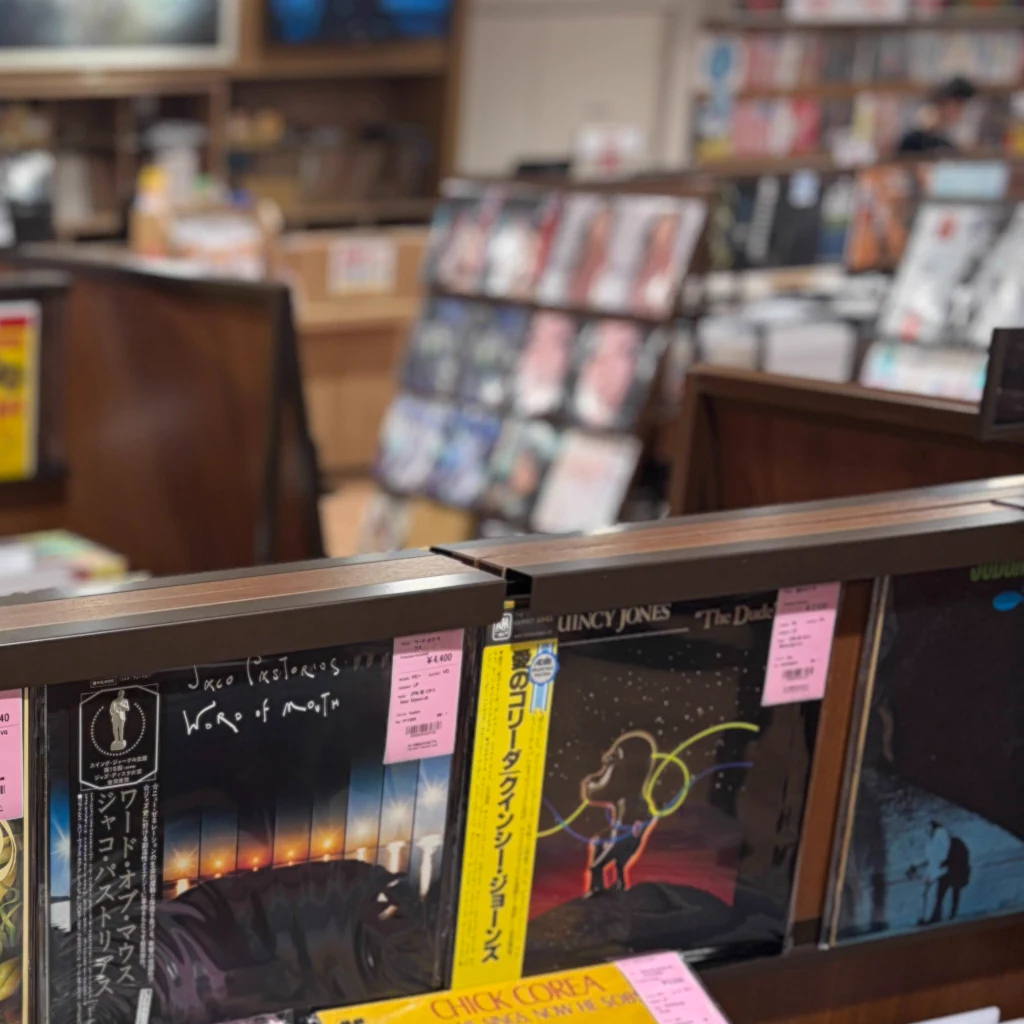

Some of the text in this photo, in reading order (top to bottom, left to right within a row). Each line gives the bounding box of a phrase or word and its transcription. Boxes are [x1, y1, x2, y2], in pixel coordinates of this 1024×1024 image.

[557, 609, 614, 633] UINCY
[616, 604, 672, 633] JONES
[117, 789, 139, 983] ワード・オブ・マウス
[430, 989, 513, 1021] CHICK
[512, 974, 607, 1007] COREA
[533, 1003, 574, 1021] NOW
[576, 999, 597, 1014] HE
